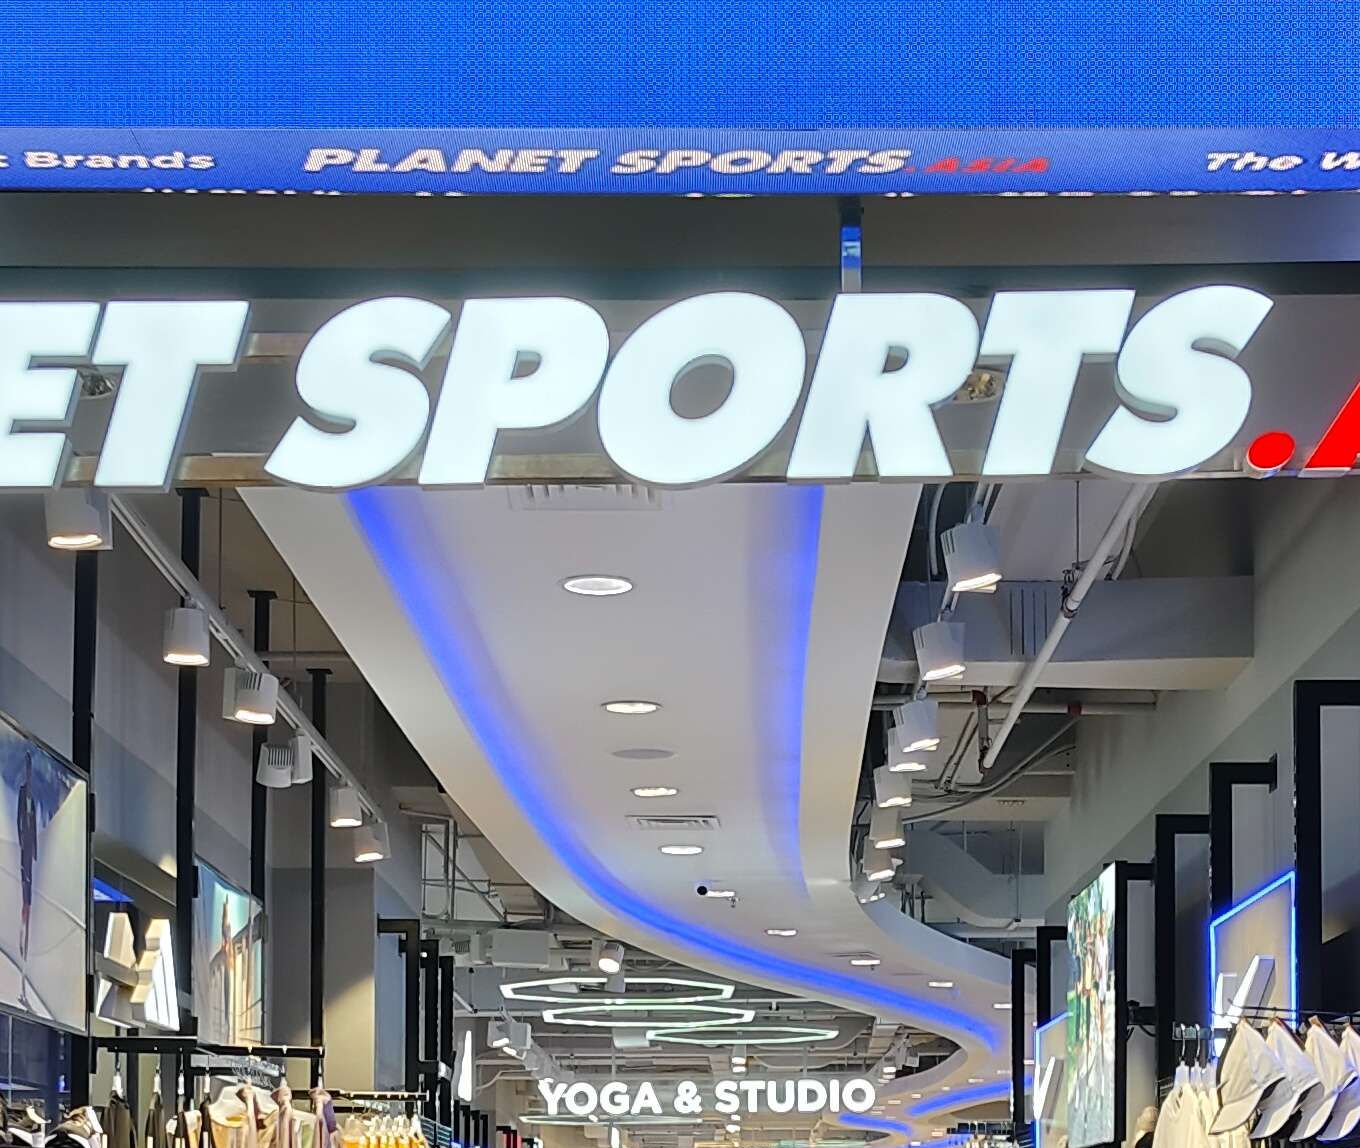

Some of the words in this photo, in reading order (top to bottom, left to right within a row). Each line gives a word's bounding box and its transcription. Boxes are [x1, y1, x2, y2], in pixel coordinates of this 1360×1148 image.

[24, 151, 215, 169] Brands
[303, 148, 600, 174] PLANET
[1206, 151, 1304, 171] The
[538, 1078, 664, 1116] YOGA
[673, 1081, 703, 1114] &
[714, 1078, 877, 1114] STUDIO
